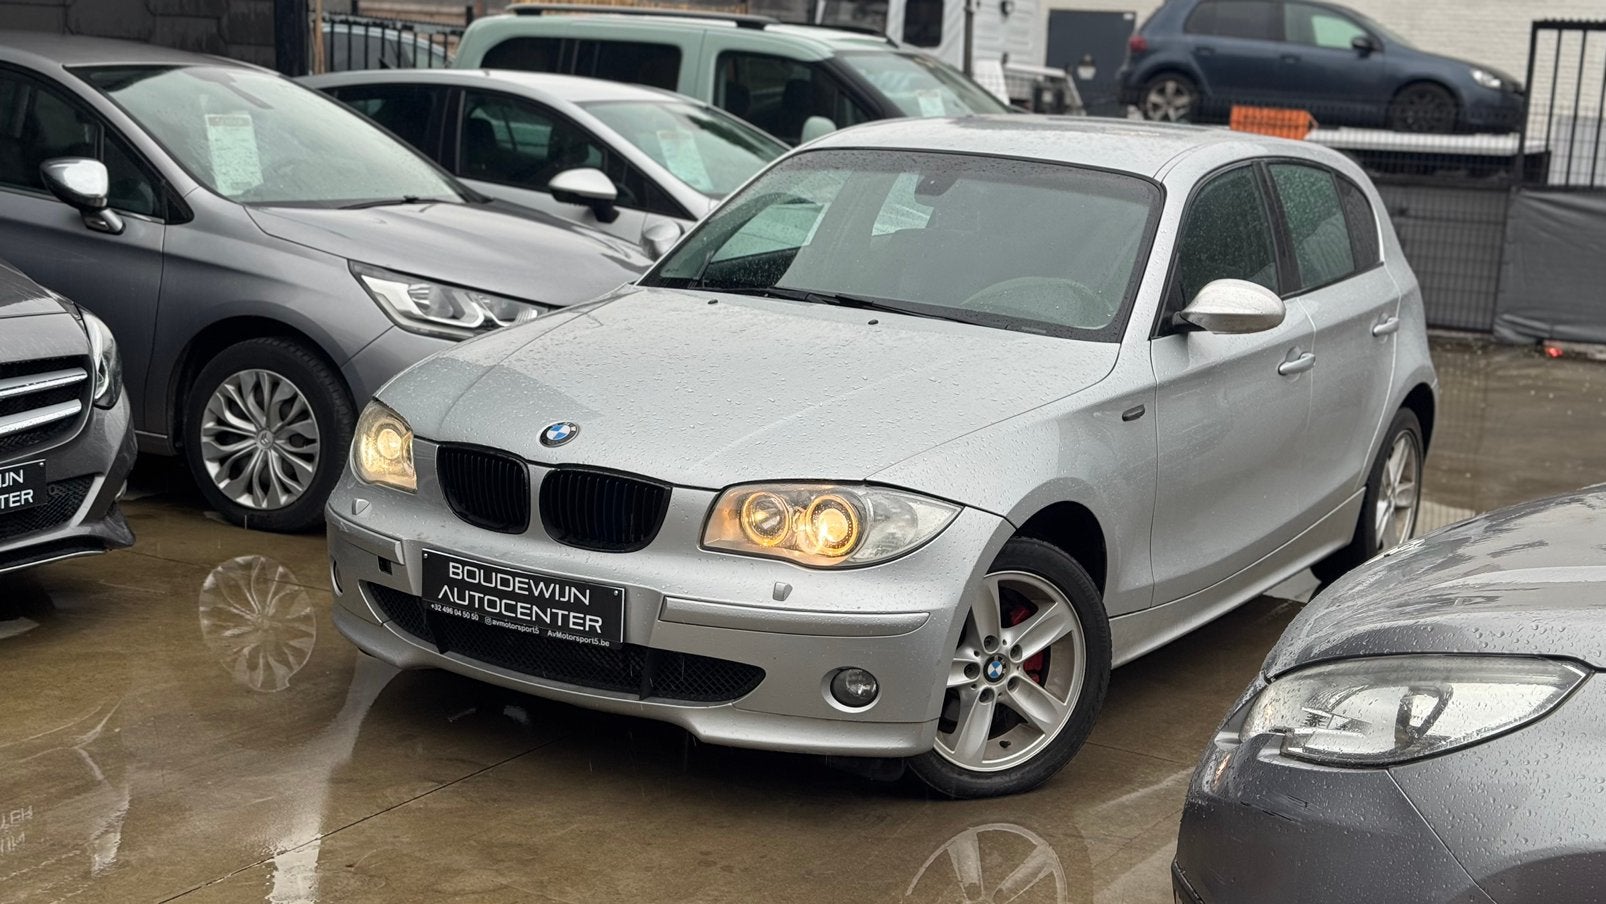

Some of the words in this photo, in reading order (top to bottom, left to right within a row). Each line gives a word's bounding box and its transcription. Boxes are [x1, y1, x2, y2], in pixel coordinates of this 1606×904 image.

[449, 561, 590, 606] BOUDEWIJN
[431, 603, 442, 612] +32
[442, 606, 454, 615] 496
[453, 609, 462, 617] 04
[462, 611, 471, 619] 50
[471, 613, 479, 621] 50
[438, 585, 603, 634] AUTOCENTER
